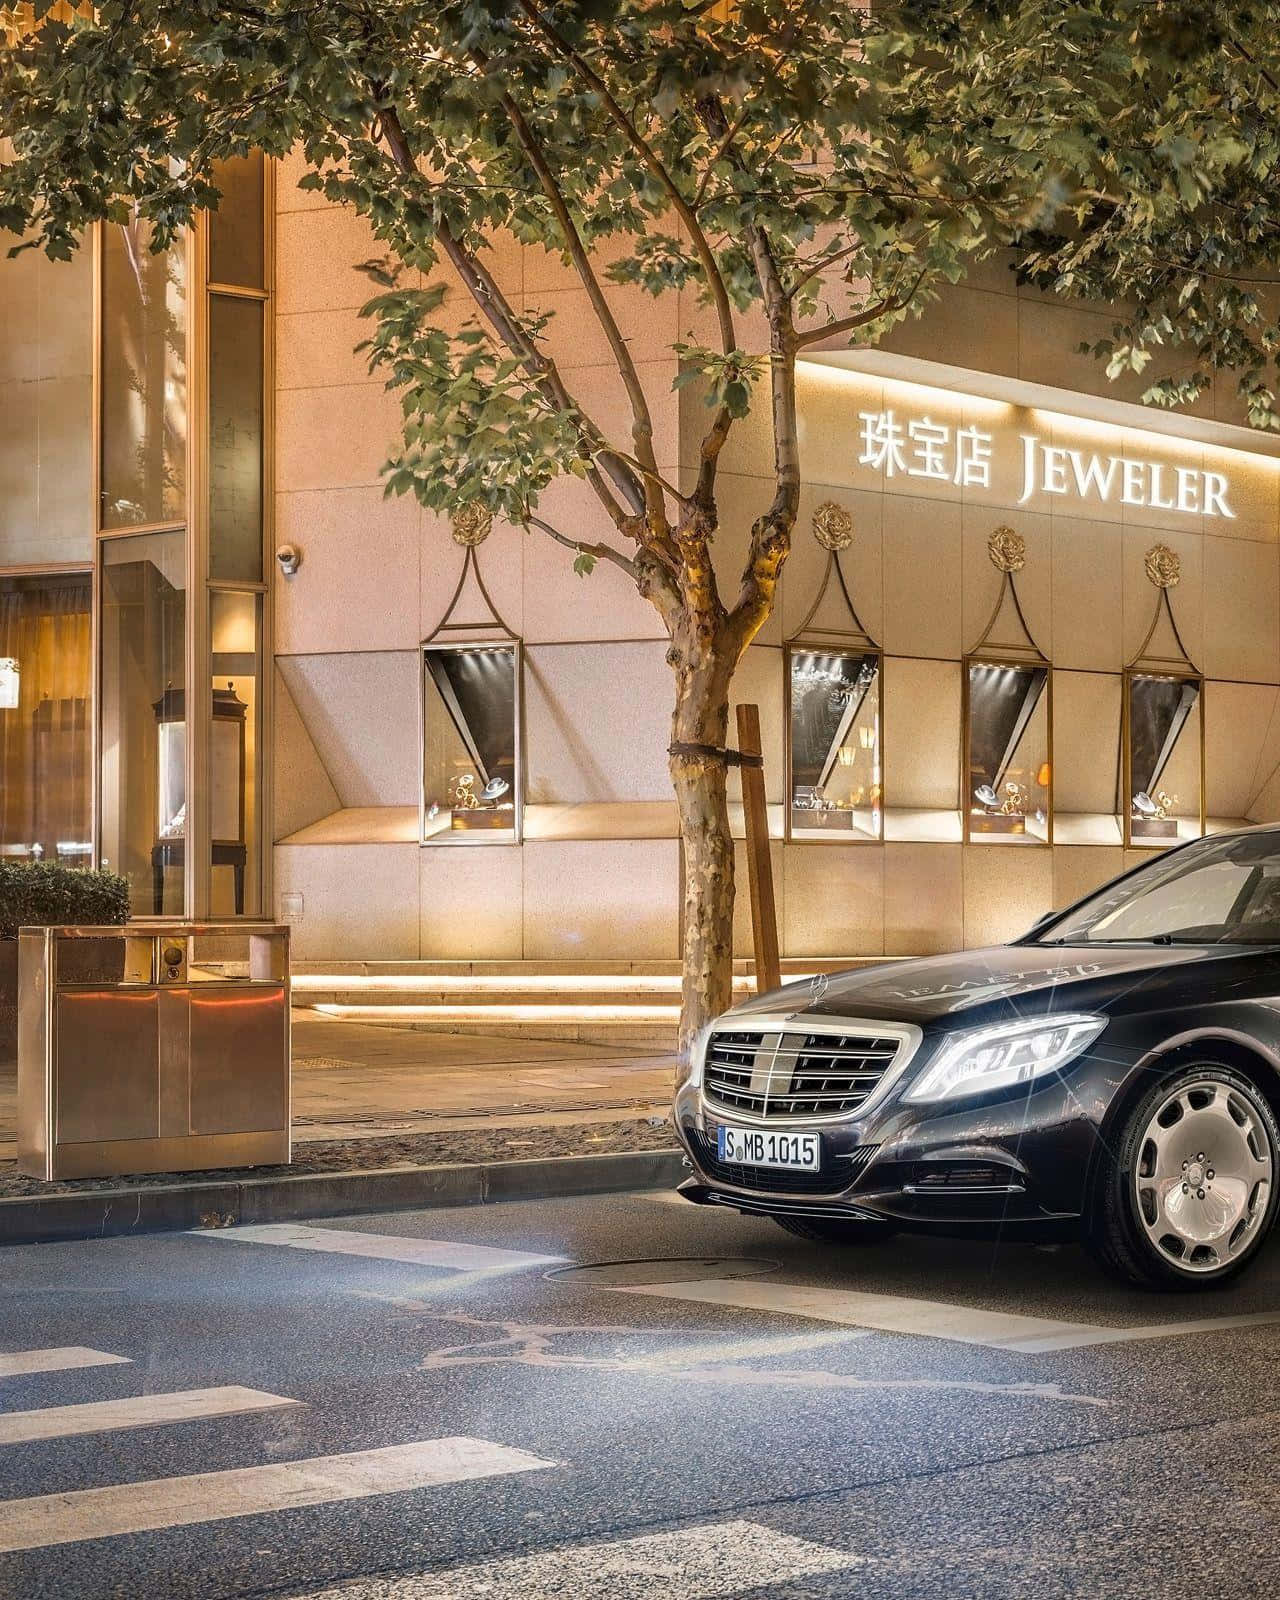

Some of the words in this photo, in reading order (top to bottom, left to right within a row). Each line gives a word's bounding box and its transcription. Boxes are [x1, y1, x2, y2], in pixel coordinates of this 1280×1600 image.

[857, 410, 993, 488] 珠宝店
[1018, 434, 1236, 518] JEWELER
